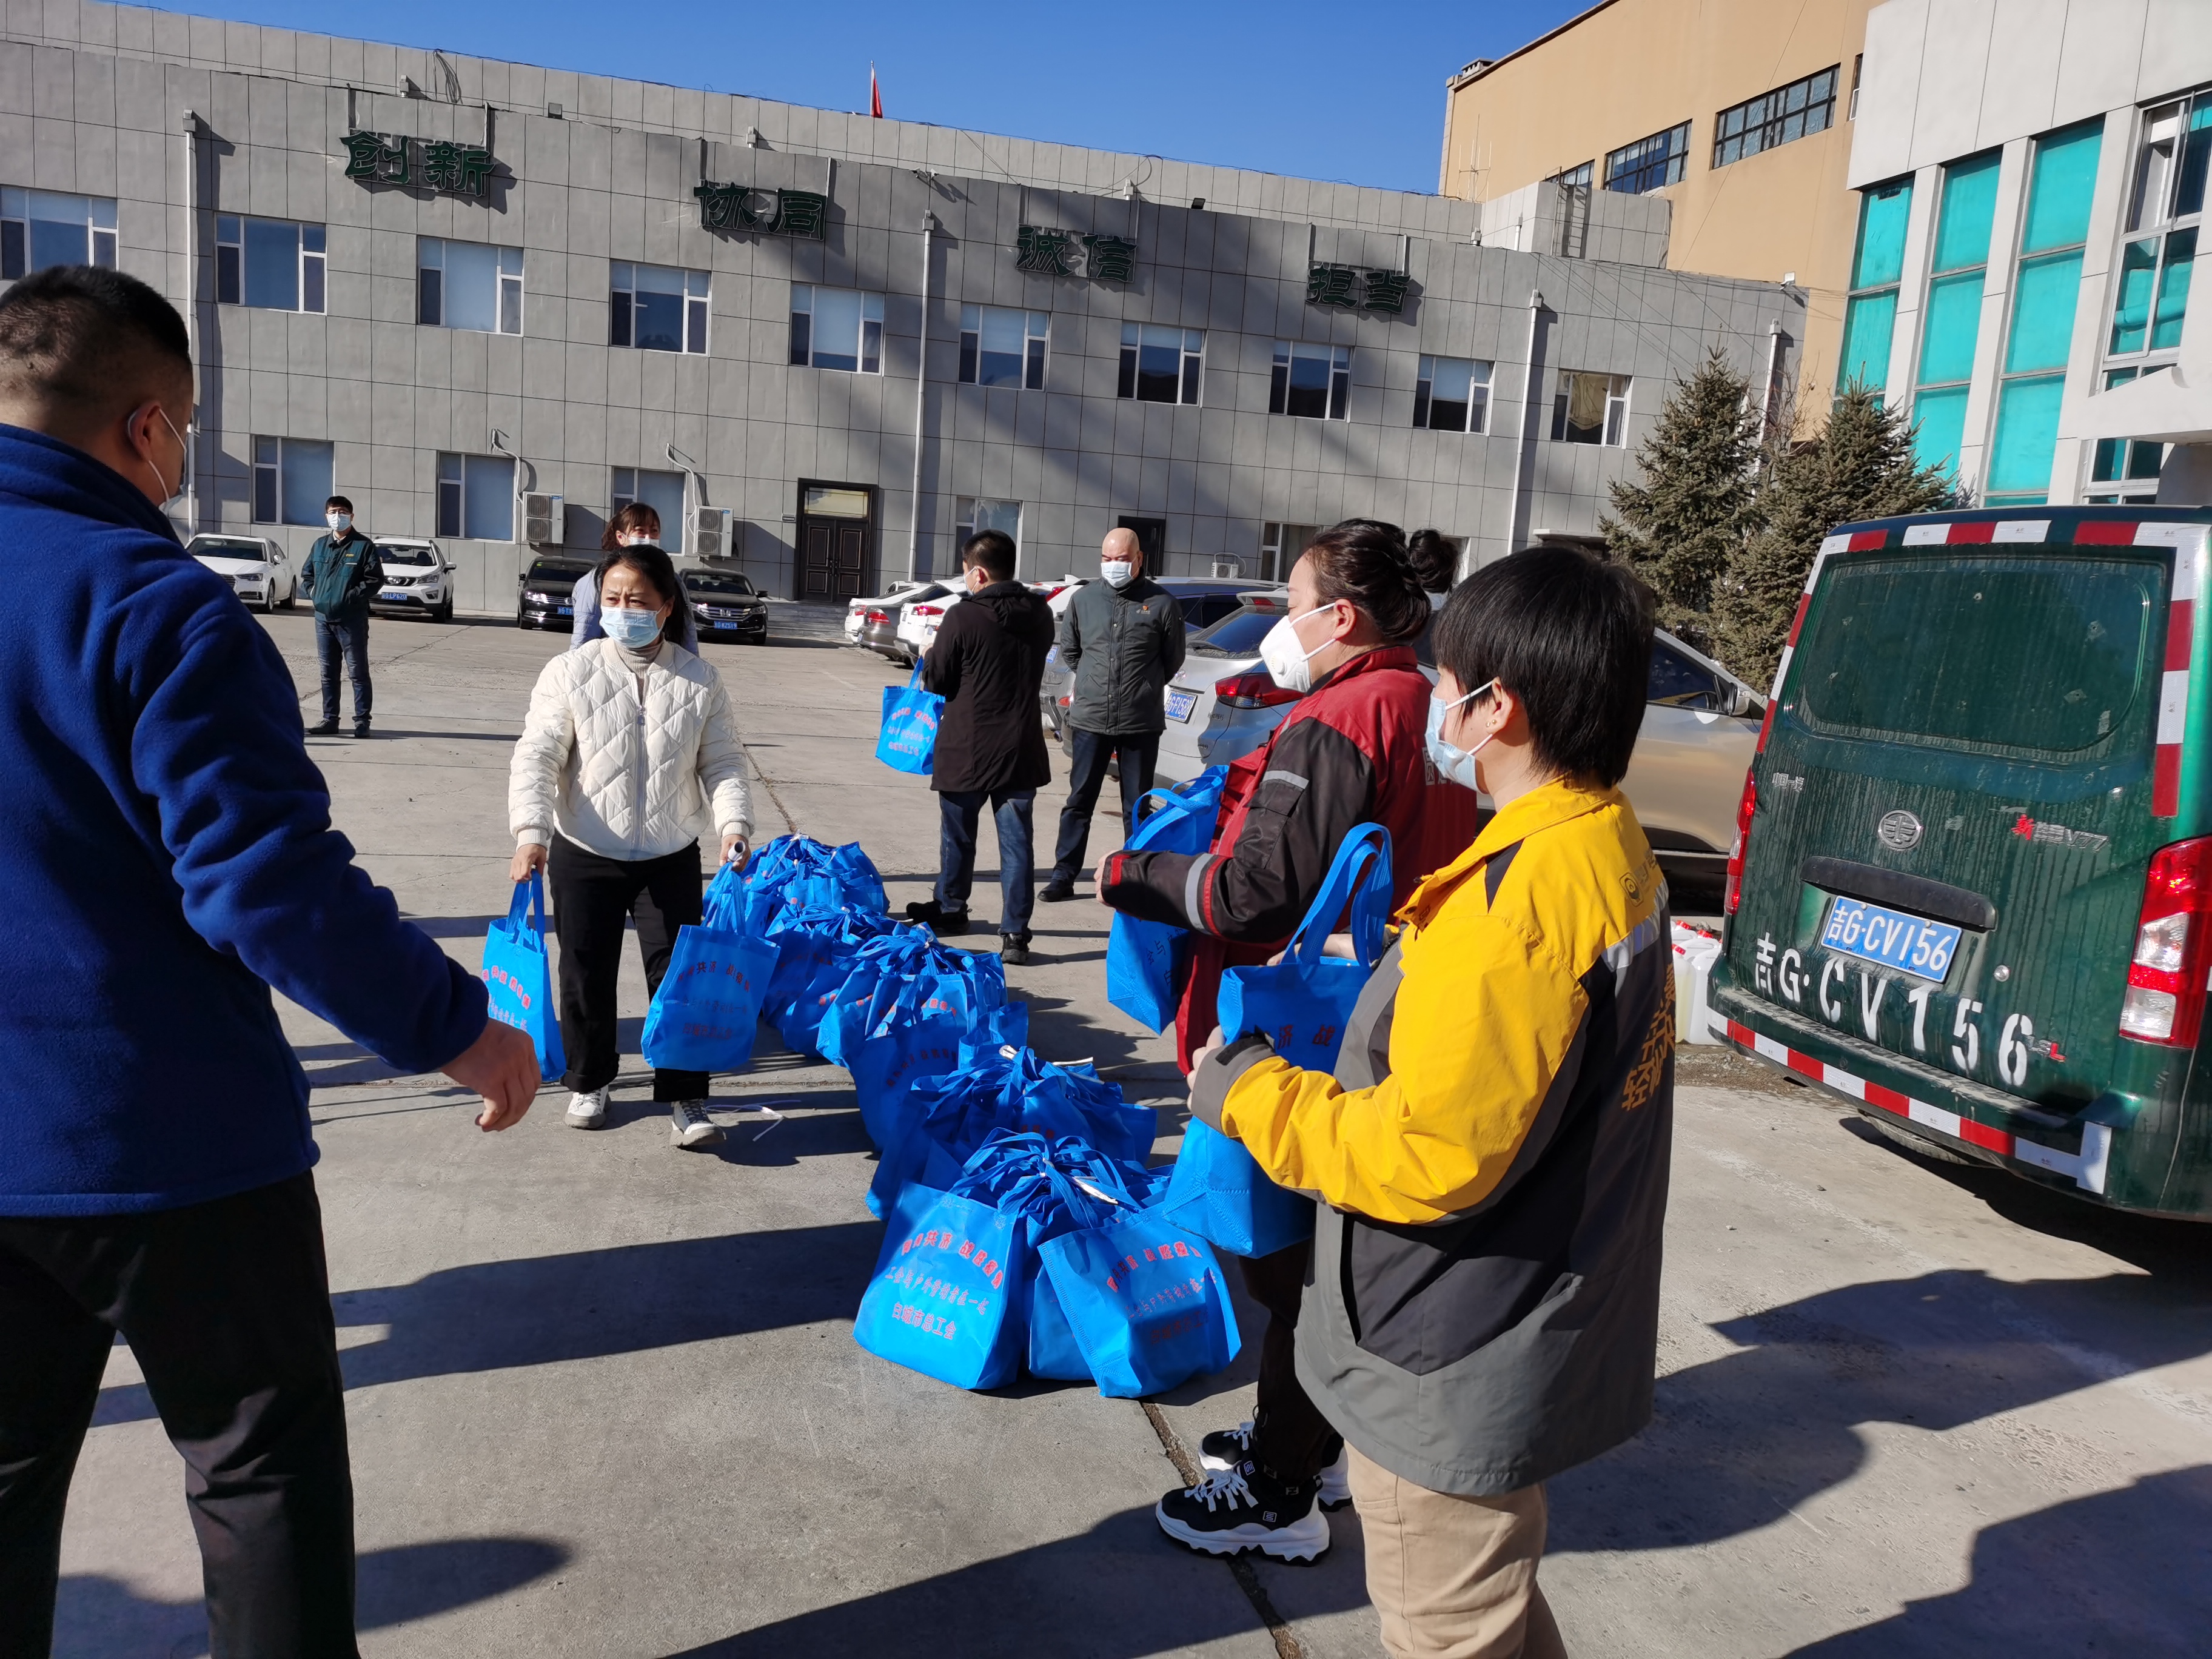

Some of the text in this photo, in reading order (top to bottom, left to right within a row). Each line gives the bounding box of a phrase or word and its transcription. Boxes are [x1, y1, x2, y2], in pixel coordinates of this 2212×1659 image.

[339, 130, 496, 197] 创新
[693, 180, 829, 241] 协同
[1016, 226, 1138, 283] 诚信
[1307, 263, 1410, 314] 担当
[1771, 772, 1805, 793] 中国一汽
[892, 1301, 956, 1340] 白城市总工会
